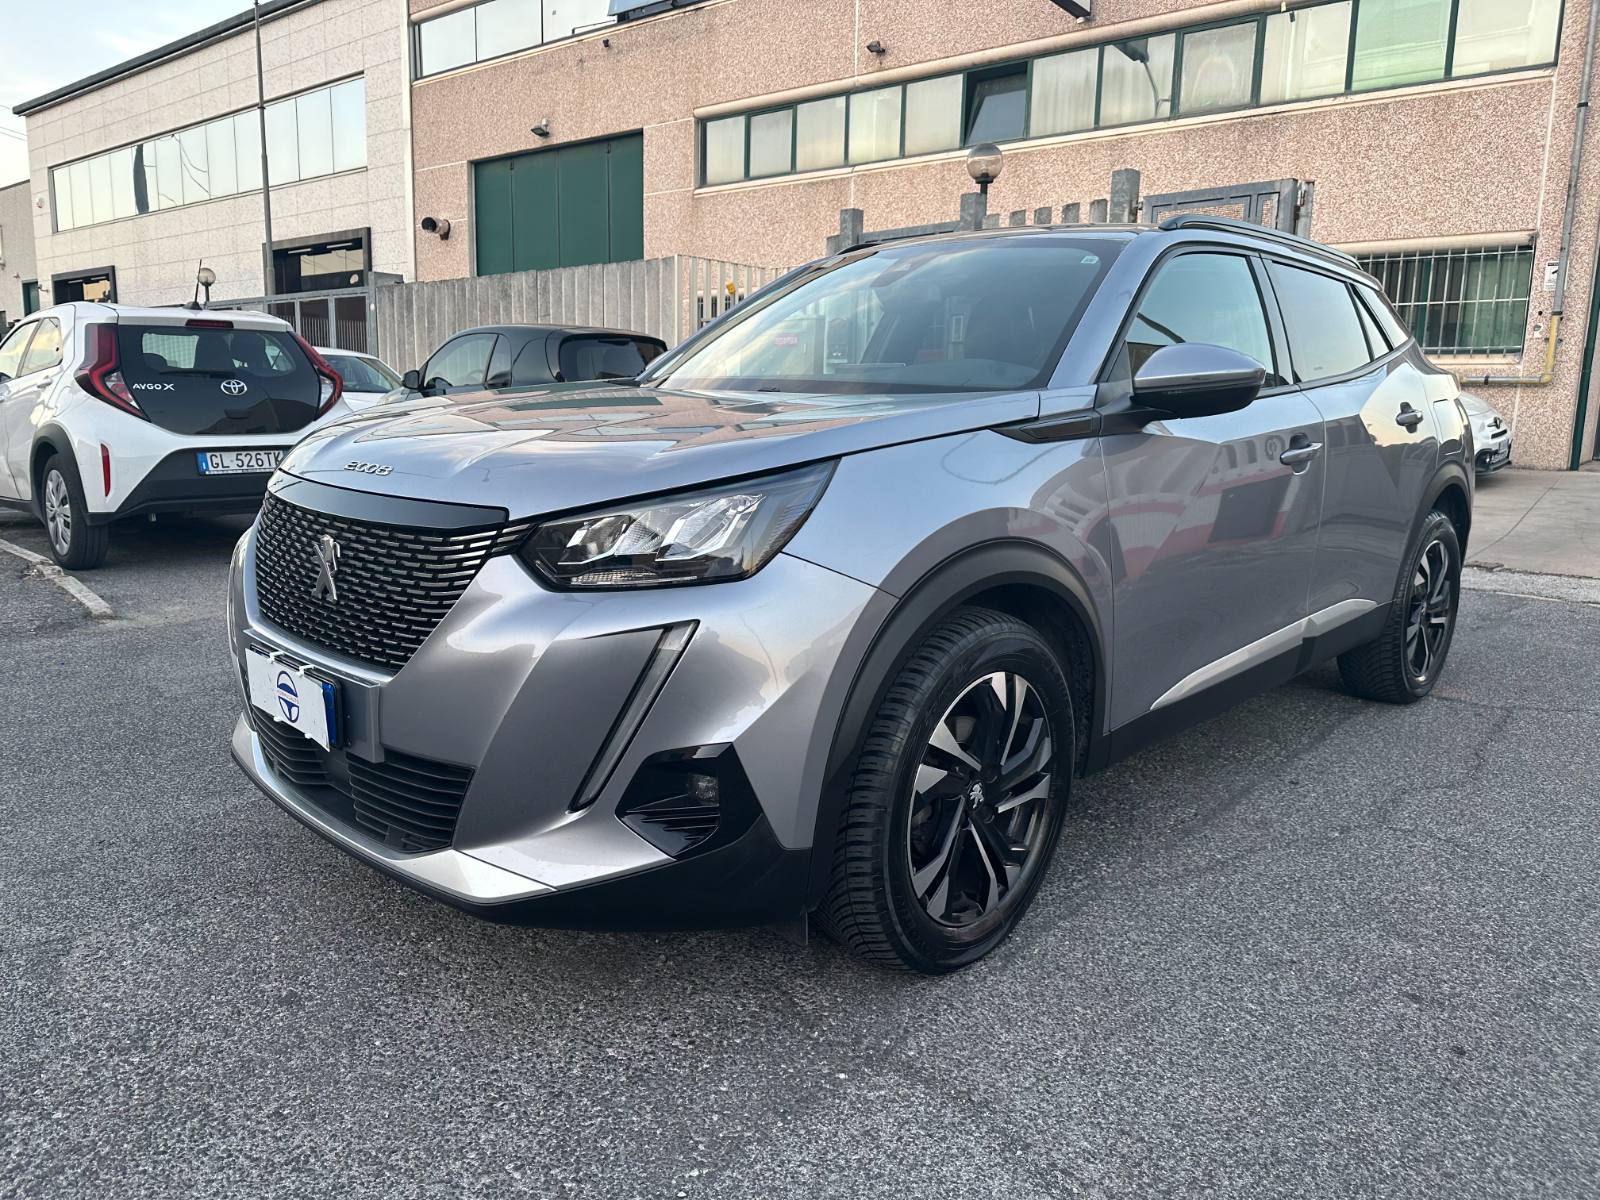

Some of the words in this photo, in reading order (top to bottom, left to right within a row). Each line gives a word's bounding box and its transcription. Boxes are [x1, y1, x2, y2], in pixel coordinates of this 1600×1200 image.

[132, 383, 162, 391] AYGO
[163, 383, 175, 391] X
[209, 453, 230, 469] GL
[235, 452, 281, 468] 526TK
[344, 460, 394, 476] 2008
